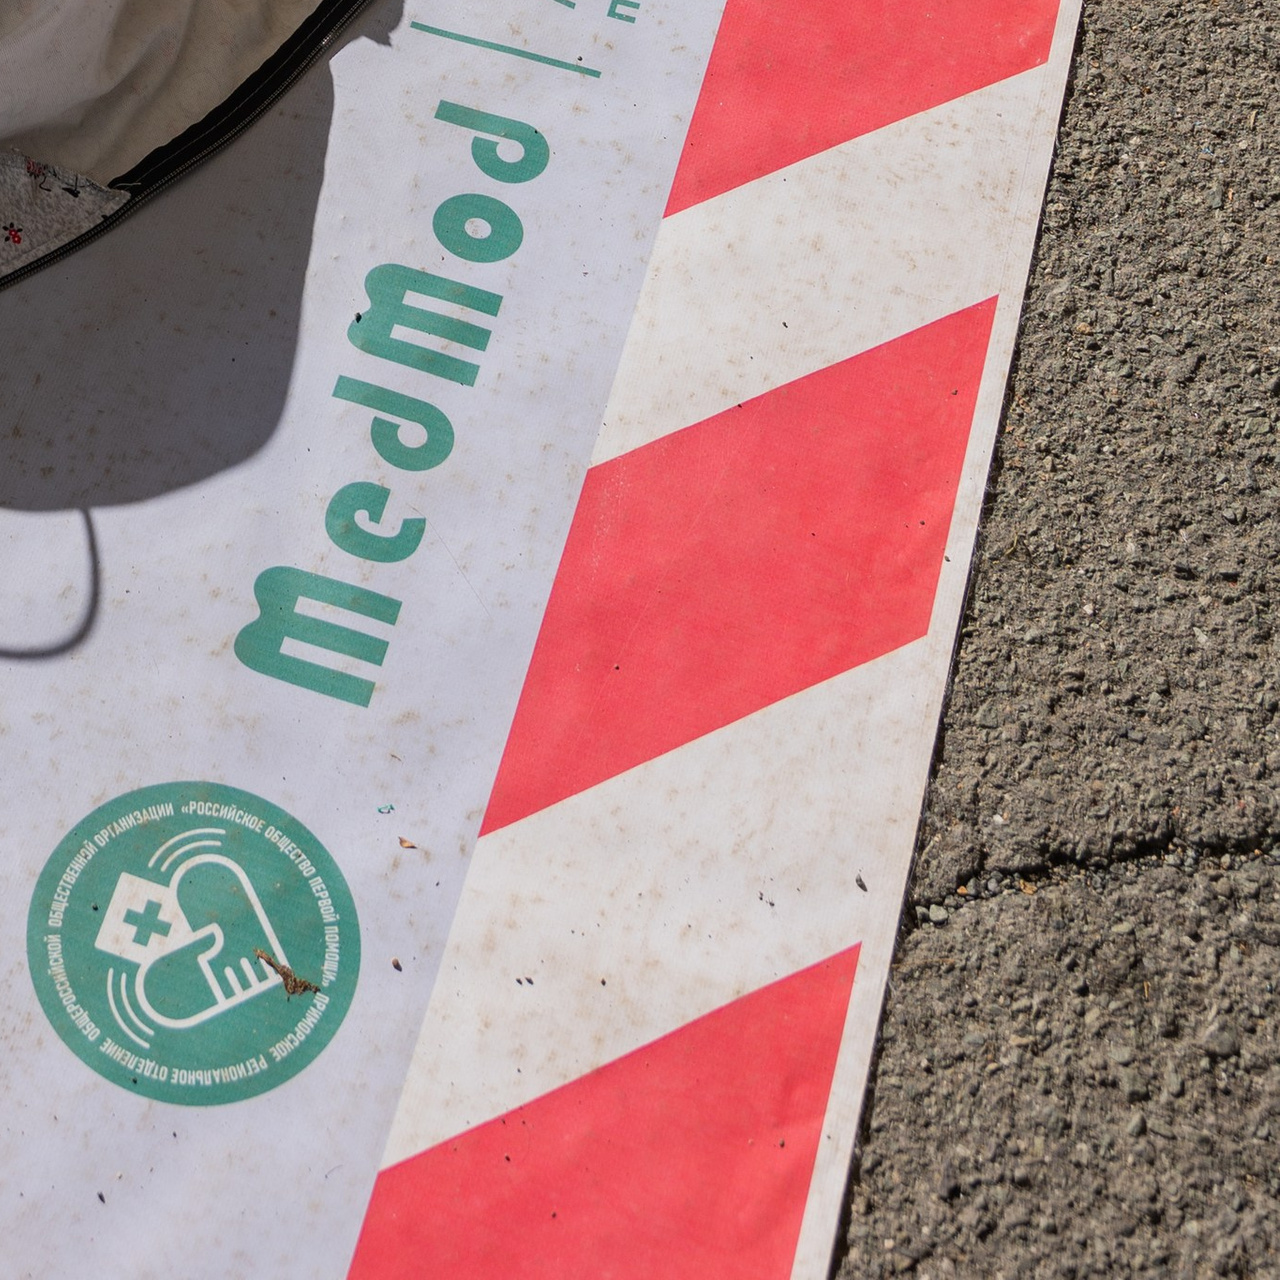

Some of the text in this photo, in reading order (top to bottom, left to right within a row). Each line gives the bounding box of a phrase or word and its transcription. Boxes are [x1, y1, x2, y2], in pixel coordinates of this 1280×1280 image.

[233, 99, 550, 708] MedMod
[94, 802, 174, 847] ОРГАНИЗАЦИИ
[181, 800, 266, 833] «РОССИЙСКОЕ
[264, 825, 316, 878] ОБЩЕСТВО
[308, 875, 341, 924] ПЕРВОЙ
[322, 925, 340, 988] ПОМОЩИ»
[44, 934, 101, 1042] ОБЩЕРОССИЙСКОЙ
[271, 992, 330, 1063] ПРИМОРСКОЕ
[99, 1036, 169, 1082] ОТДЕЛЕНИЕ
[171, 1054, 269, 1086] РЕГИОНАЛЬНОЕ
